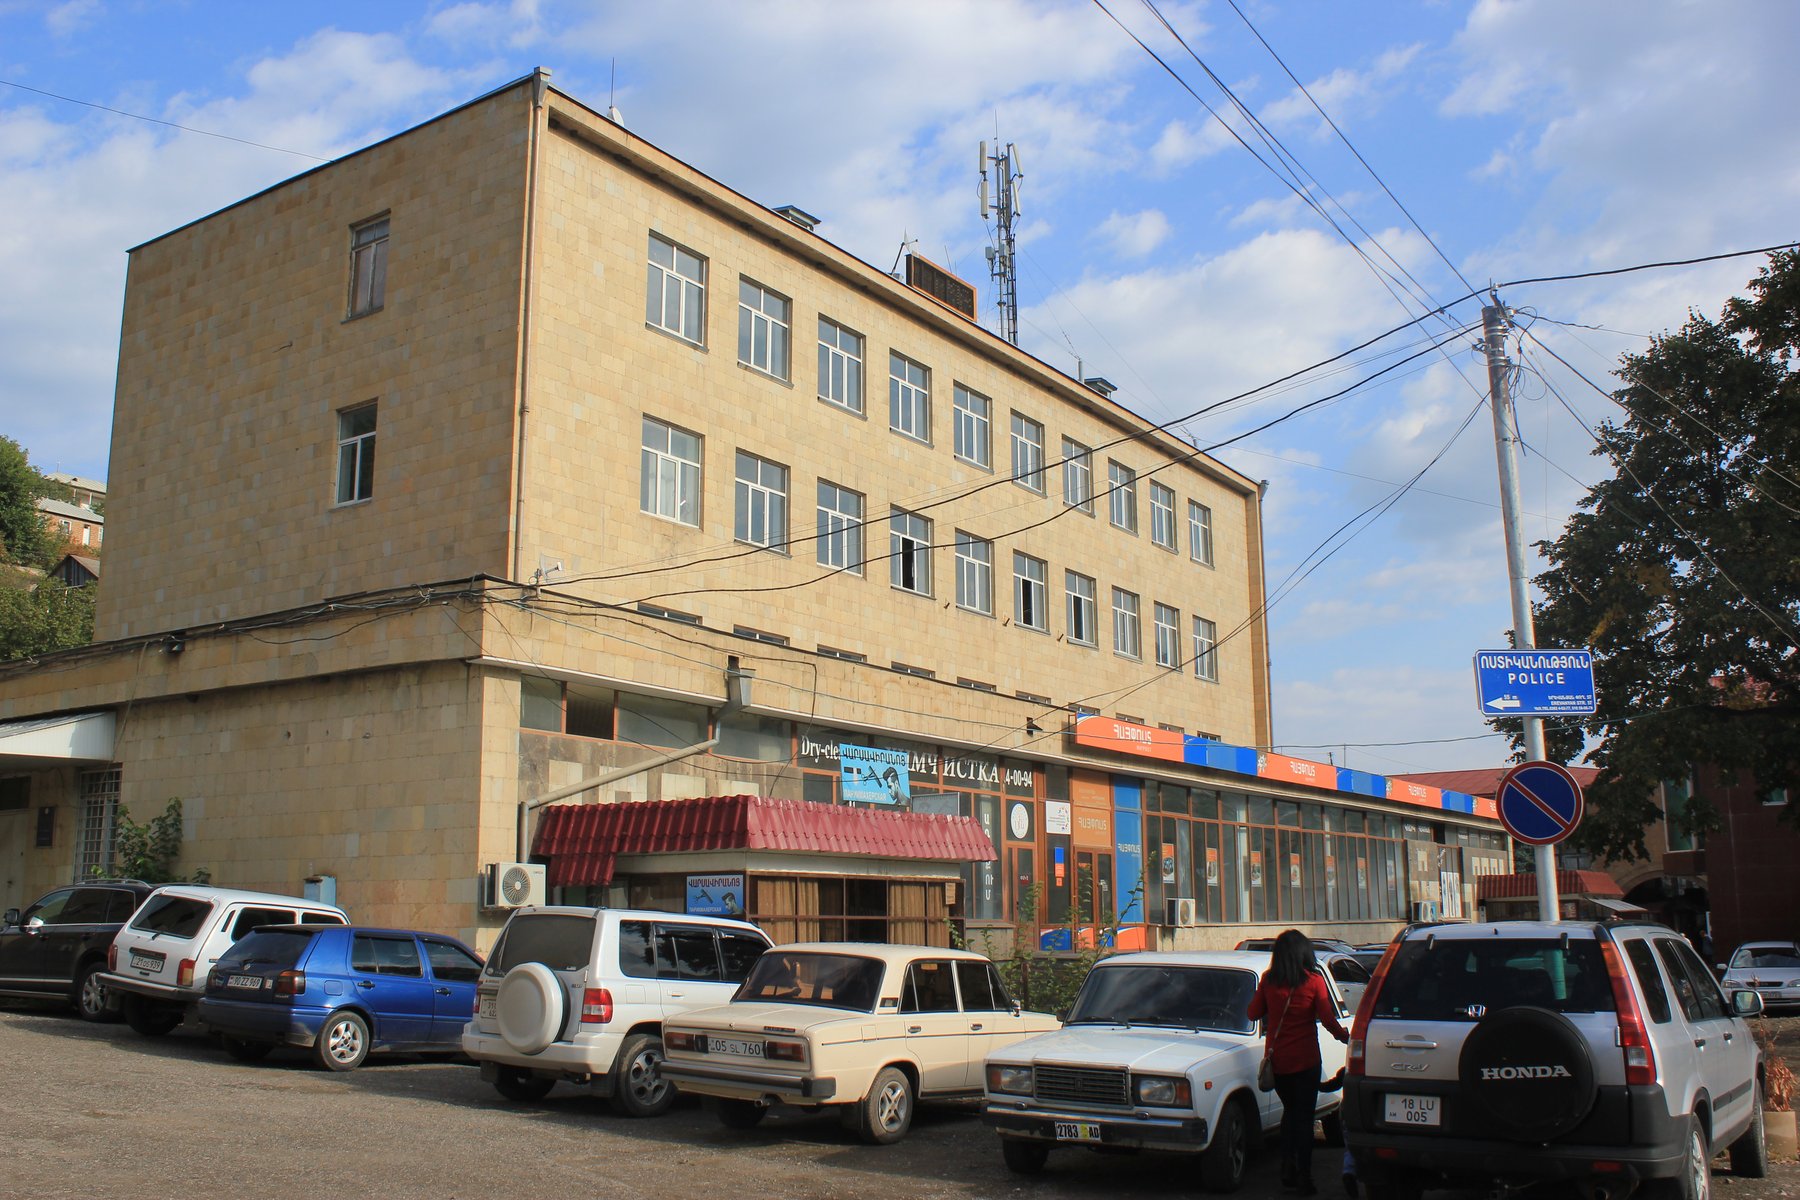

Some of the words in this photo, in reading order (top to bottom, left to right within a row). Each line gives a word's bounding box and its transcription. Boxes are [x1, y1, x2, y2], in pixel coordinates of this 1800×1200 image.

[1508, 673, 1565, 684] POLICE
[1113, 723, 1152, 745] ՀԱՅՓՈՍՏ
[842, 747, 906, 767] ՎԱՐՍԱՎԻՐԱՆՈՑ
[1004, 768, 1033, 788] 4-00-94
[715, 1040, 727, 1052] 05
[730, 1043, 740, 1053] SL
[742, 1043, 761, 1055] 760
[1481, 1065, 1572, 1080] HONDA
[1401, 1098, 1415, 1110] 18
[1419, 1098, 1434, 1111] LU
[1406, 1110, 1428, 1122] 005
[1057, 1124, 1079, 1138] 2783
